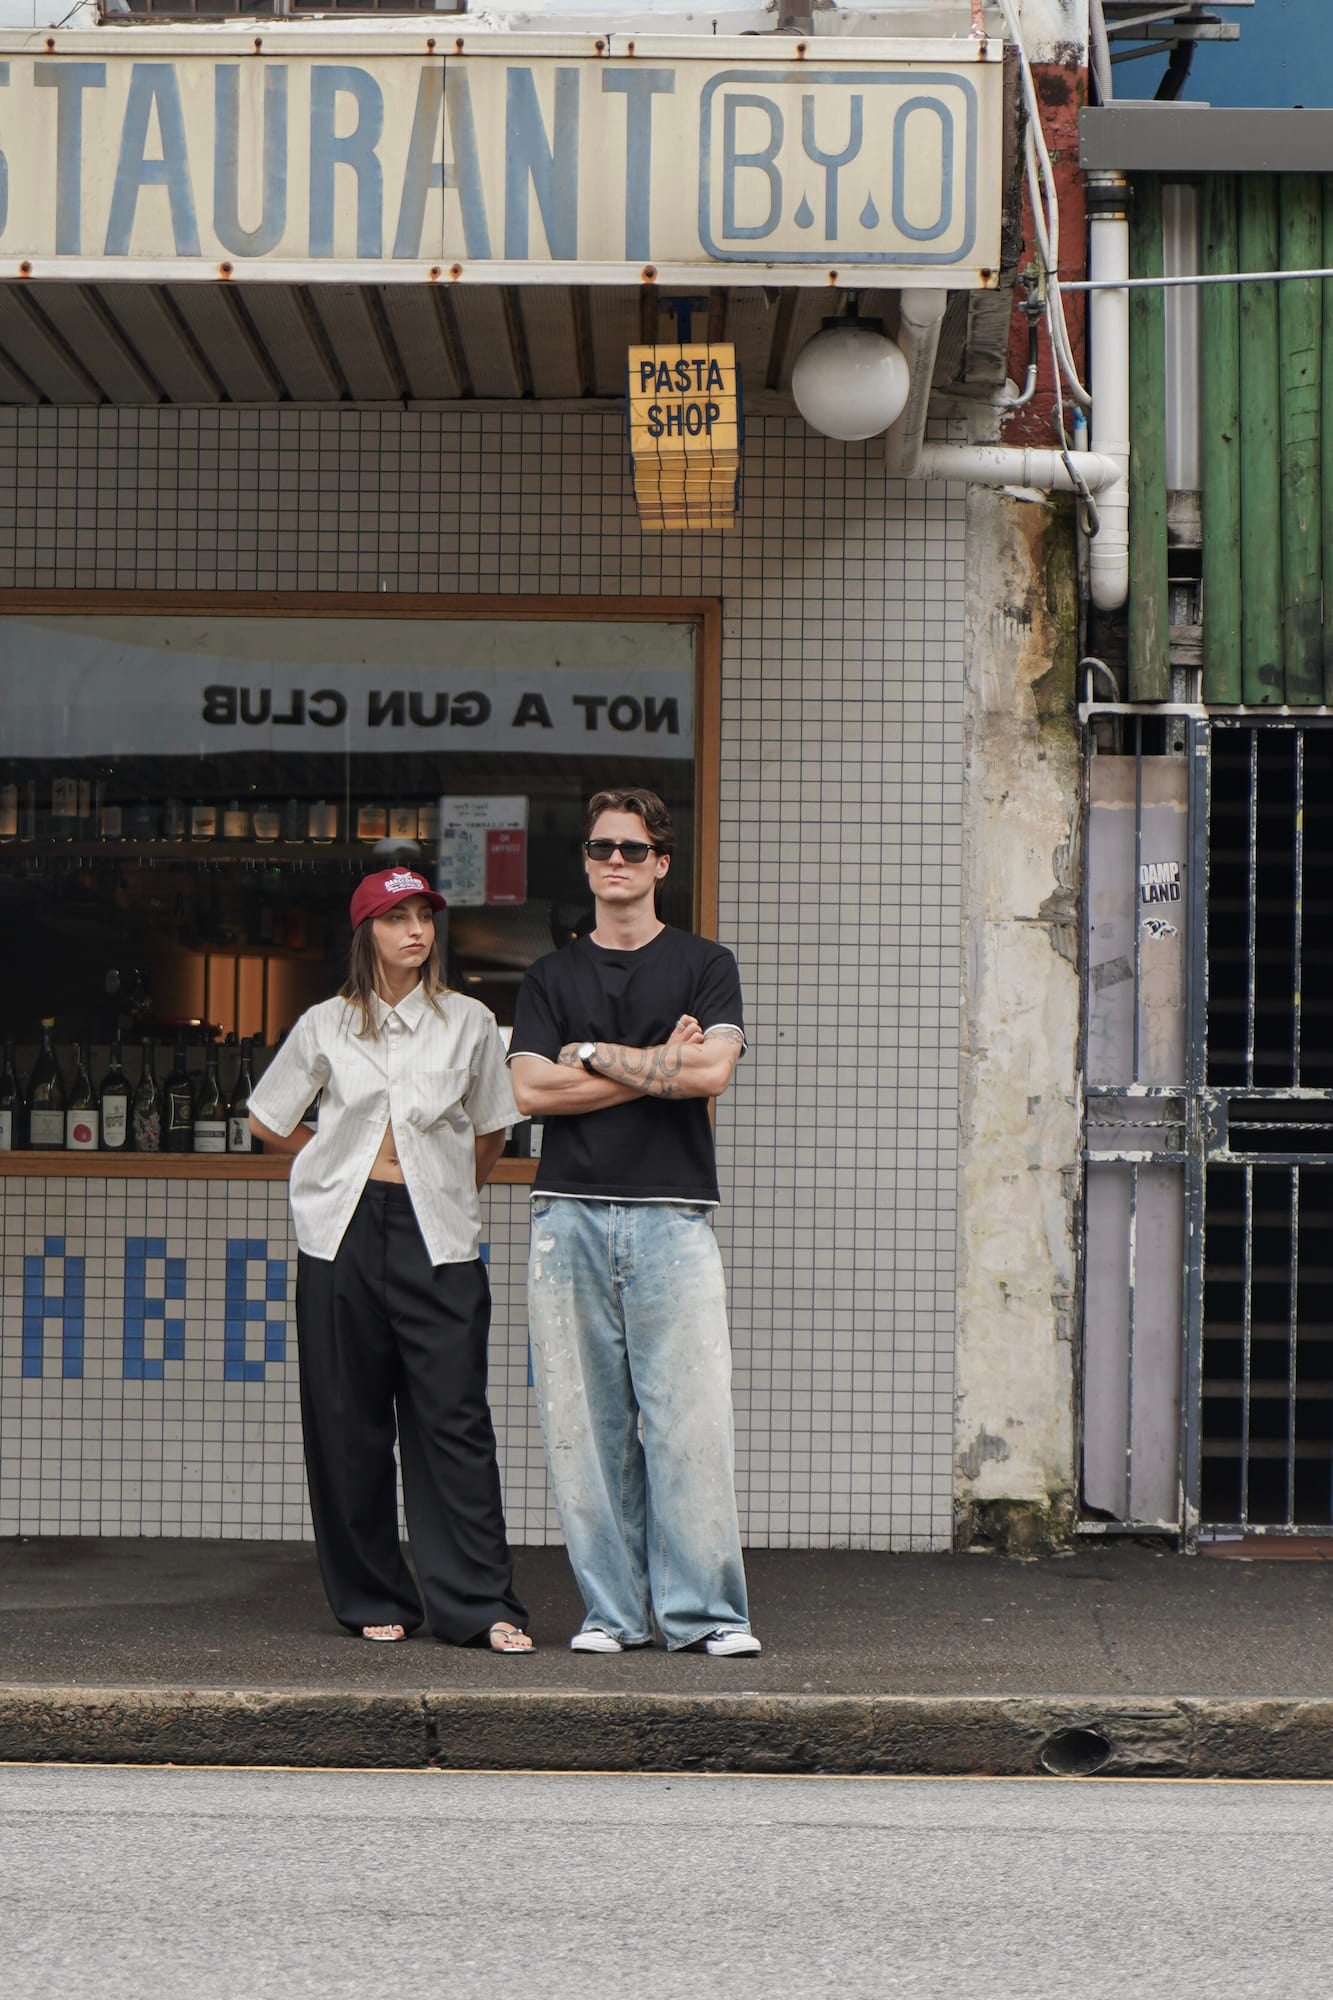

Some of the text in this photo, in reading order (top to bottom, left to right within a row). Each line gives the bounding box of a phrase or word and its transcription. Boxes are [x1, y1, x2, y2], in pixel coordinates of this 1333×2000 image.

[0, 61, 676, 261] TAURANT
[640, 359, 724, 393] PASTA
[647, 403, 720, 437] SHOP
[1140, 862, 1179, 884] DAMP
[1141, 883, 1181, 903] LAND
